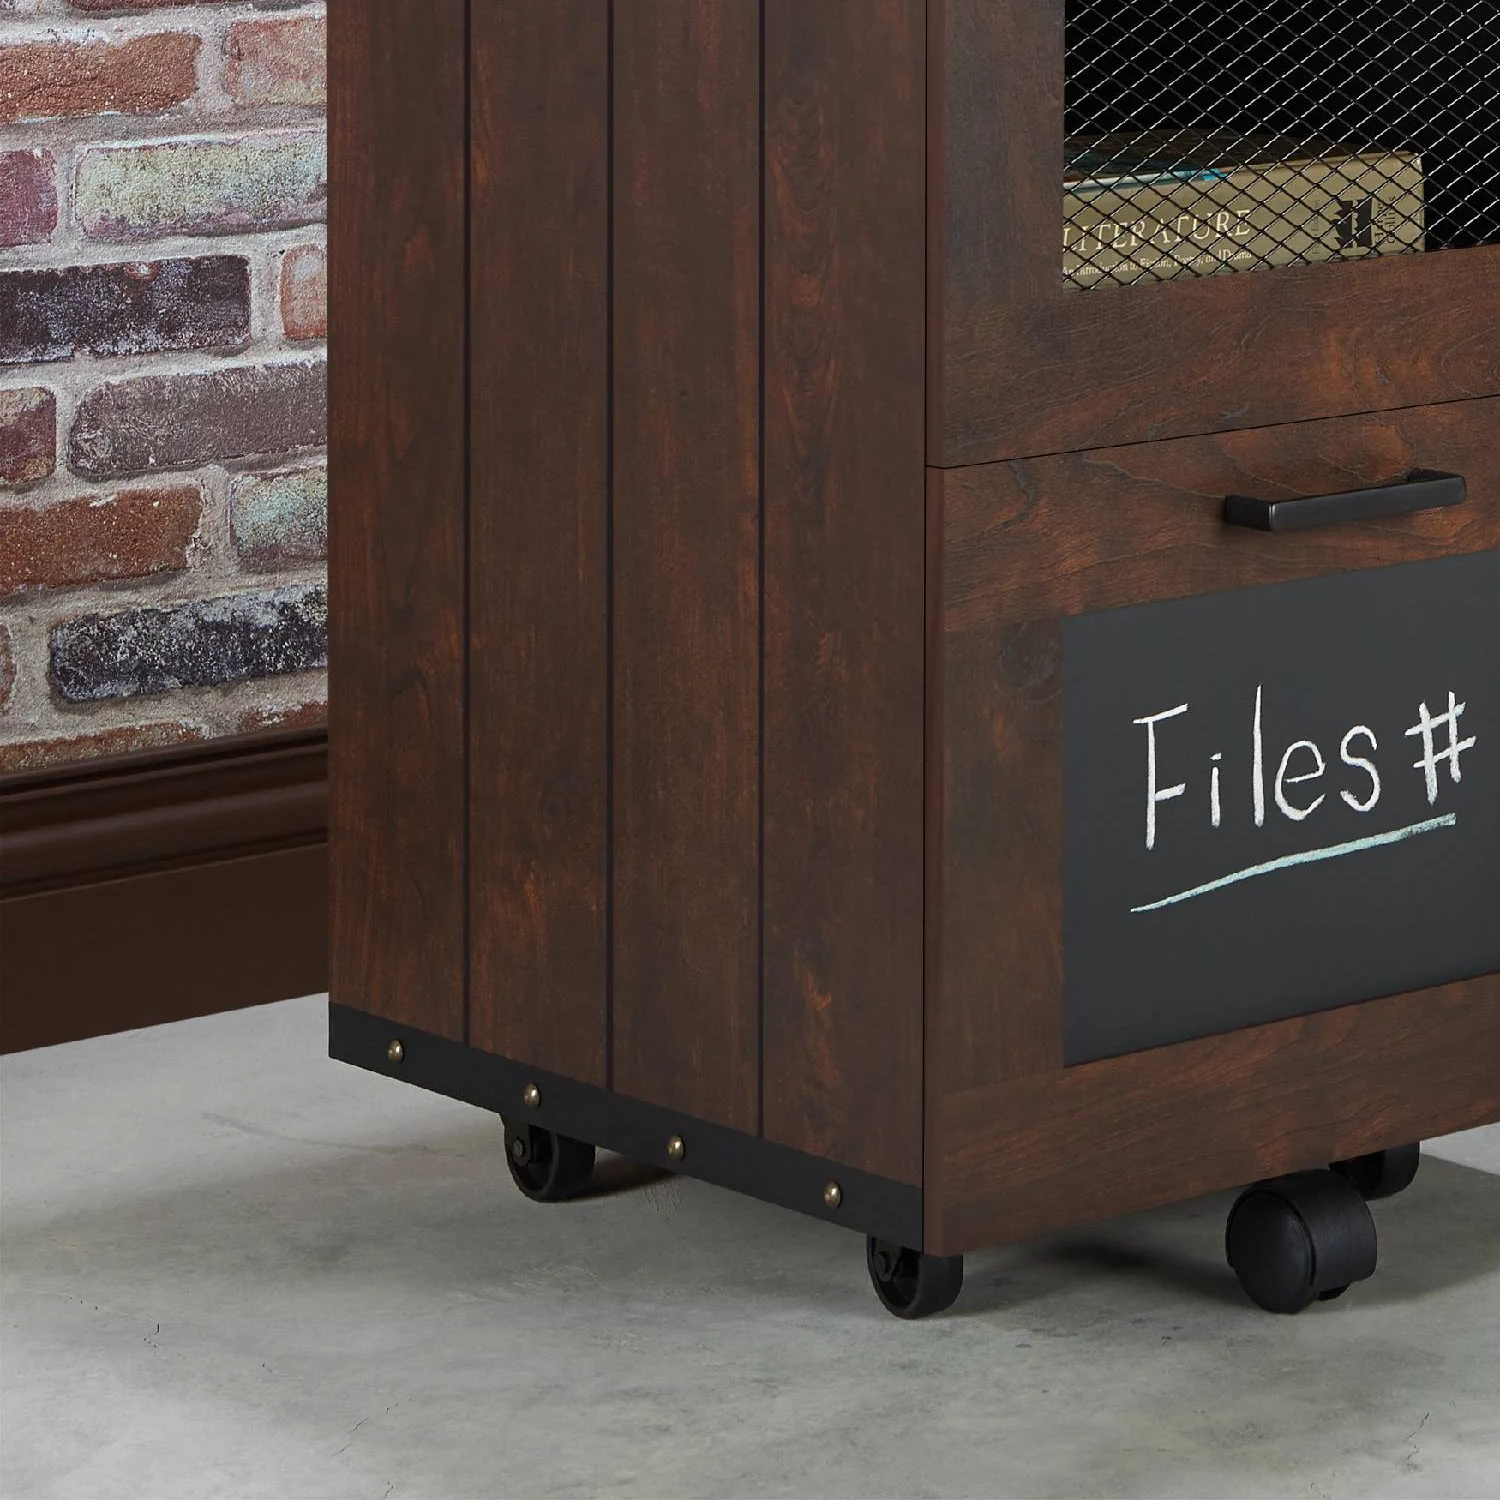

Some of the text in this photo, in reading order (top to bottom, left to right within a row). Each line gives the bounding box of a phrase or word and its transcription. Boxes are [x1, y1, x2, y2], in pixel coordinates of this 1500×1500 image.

[1063, 210, 1252, 252] LITERATURE
[1076, 261, 1127, 276] ntroducton
[1222, 250, 1252, 261] Dama
[1132, 684, 1477, 851] Files #
